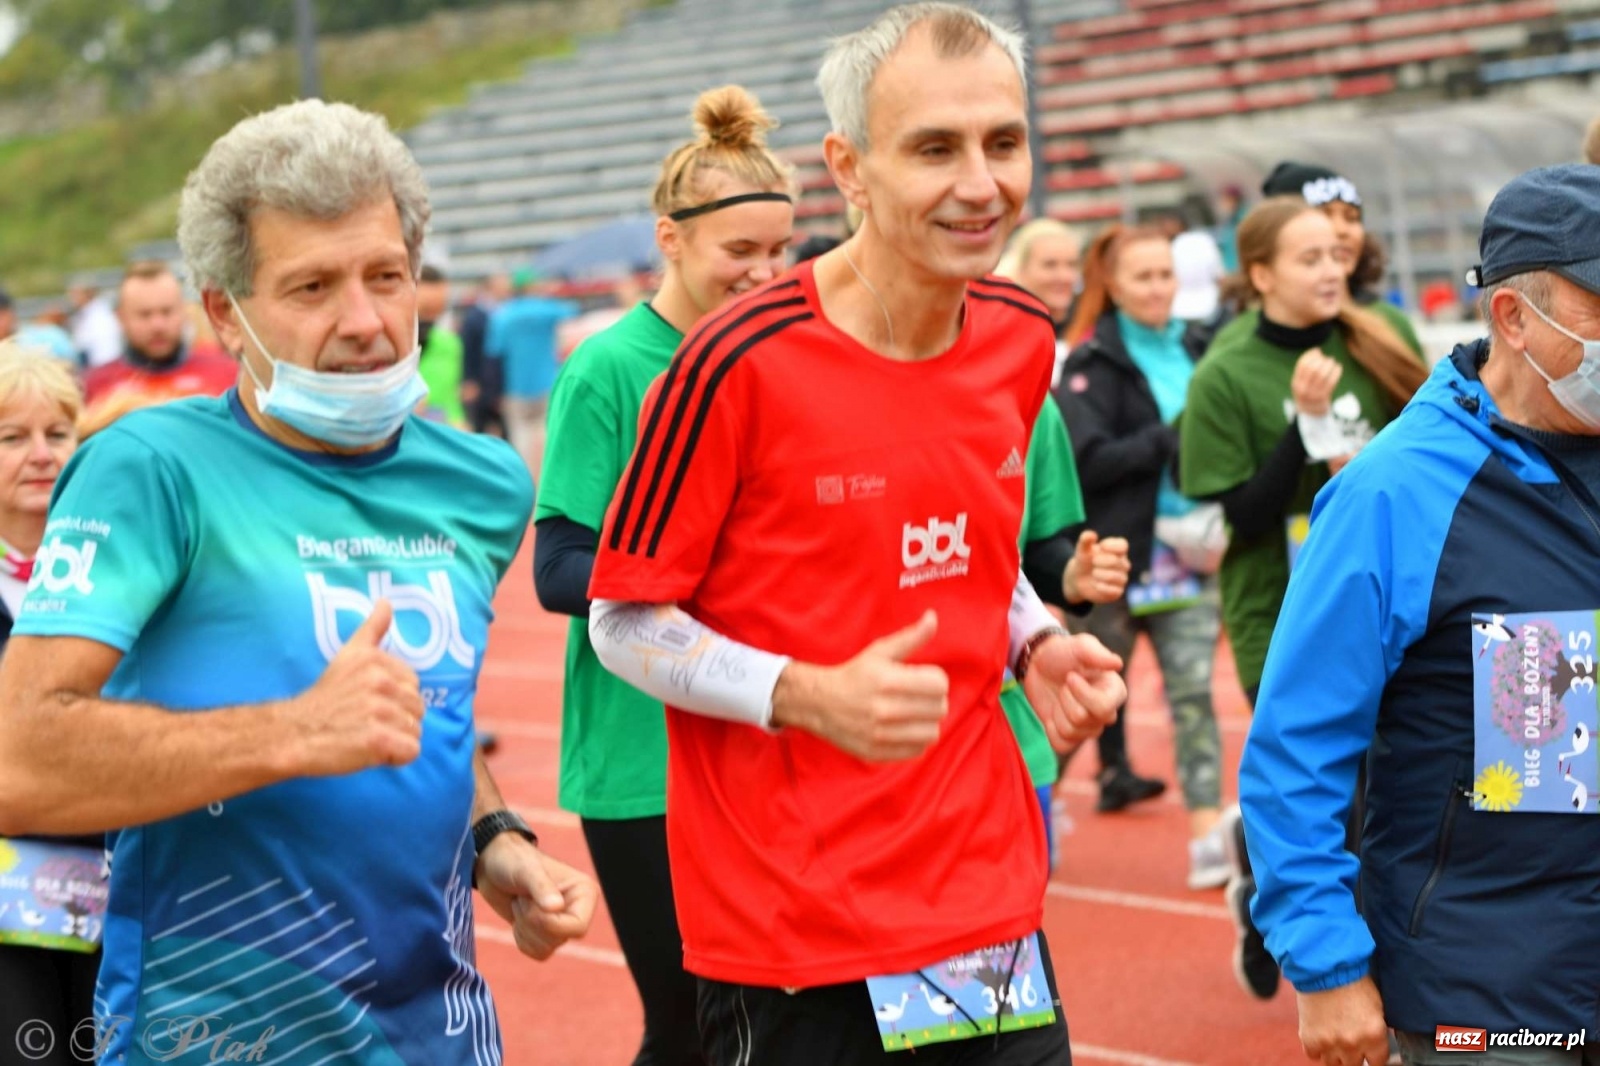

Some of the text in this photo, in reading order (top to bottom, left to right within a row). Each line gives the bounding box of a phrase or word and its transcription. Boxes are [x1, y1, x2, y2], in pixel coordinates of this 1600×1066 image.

[902, 512, 971, 569] bbl
[1568, 630, 1594, 694] 325
[1522, 624, 1541, 788] BIEG DLA BOŻENY
[980, 973, 1038, 1015] 346
